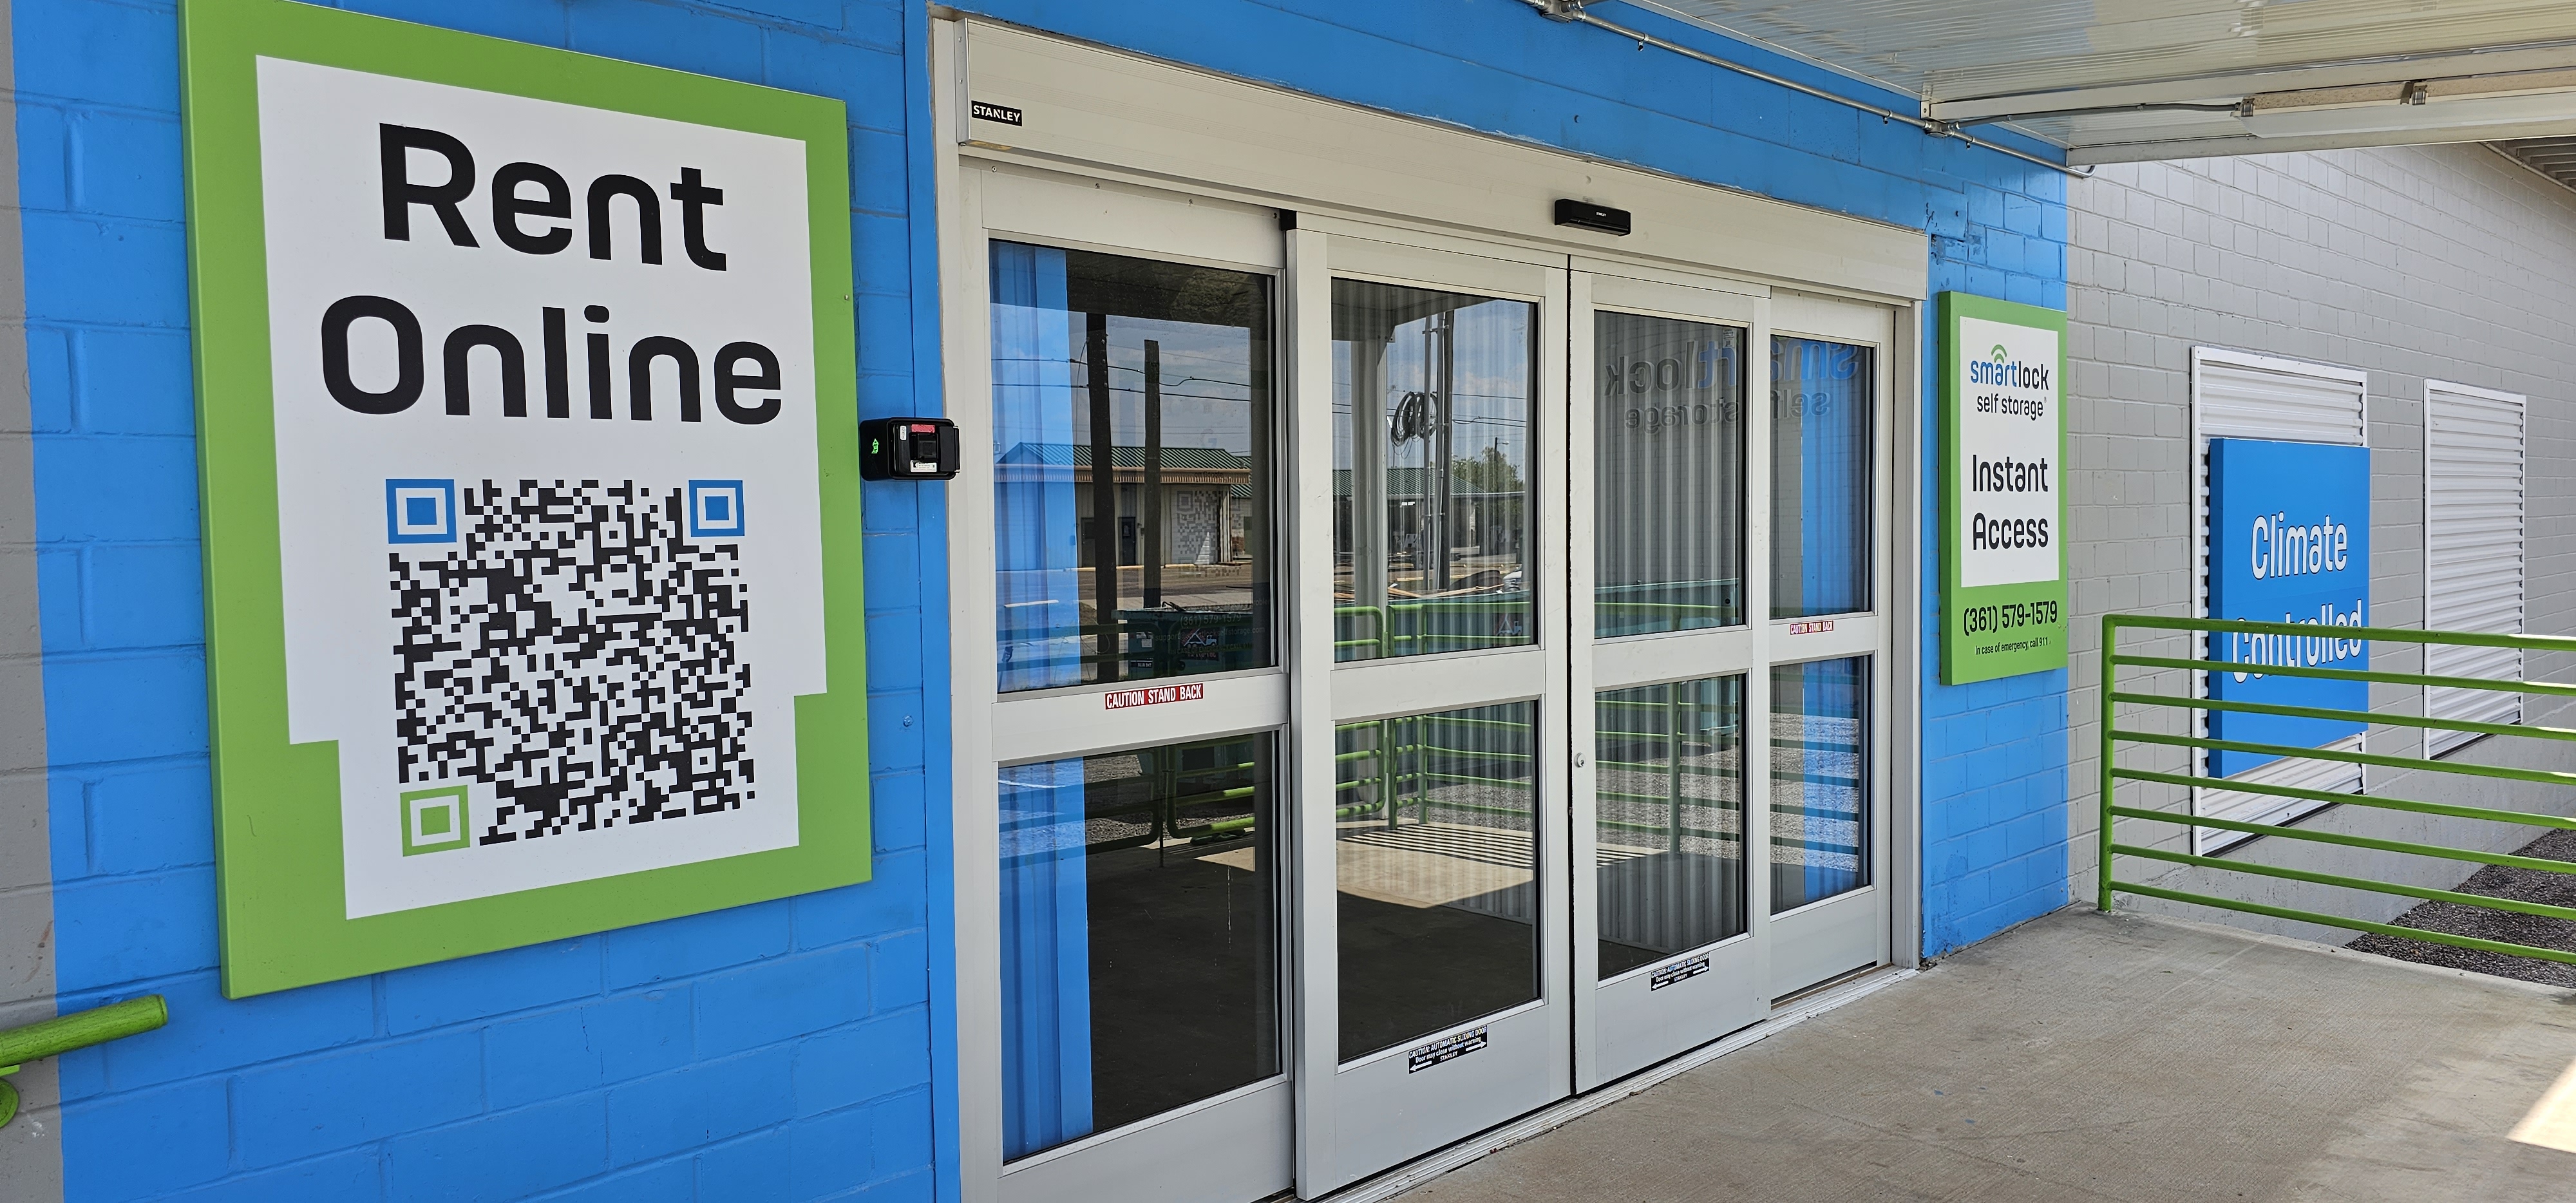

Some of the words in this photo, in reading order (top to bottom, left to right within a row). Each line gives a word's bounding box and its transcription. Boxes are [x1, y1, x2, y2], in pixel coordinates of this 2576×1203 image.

[973, 104, 1021, 122] STANLEY
[379, 122, 727, 271] Rent
[320, 294, 781, 425] Online
[1971, 360, 2049, 390] smartlock
[1977, 393, 1998, 413] self
[2002, 395, 2043, 421] storage
[1972, 454, 2049, 493] Instant
[1973, 512, 2049, 551] Access
[2251, 511, 2347, 580] Climate
[1790, 623, 1808, 634] CAUTION
[1808, 622, 1822, 632] STAND
[1823, 621, 1833, 631] BACK
[1964, 605, 1998, 636] (361)
[2002, 600, 2058, 629] 579-1579
[1975, 645, 1981, 655] In
[1981, 645, 1994, 654] case
[1994, 642, 2000, 652] of
[2029, 637, 2038, 648] call
[2232, 599, 2362, 683] Controlled
[1106, 690, 1144, 708] CAUTION
[1148, 687, 1176, 704] STAND
[1179, 684, 1202, 701] BACK
[1430, 1036, 1457, 1051] AUTOMATIC
[1457, 1030, 1475, 1042] SLIDING
[1475, 1026, 1487, 1036] DOOR
[1436, 1048, 1448, 1056] close
[1448, 1043, 1464, 1052] without
